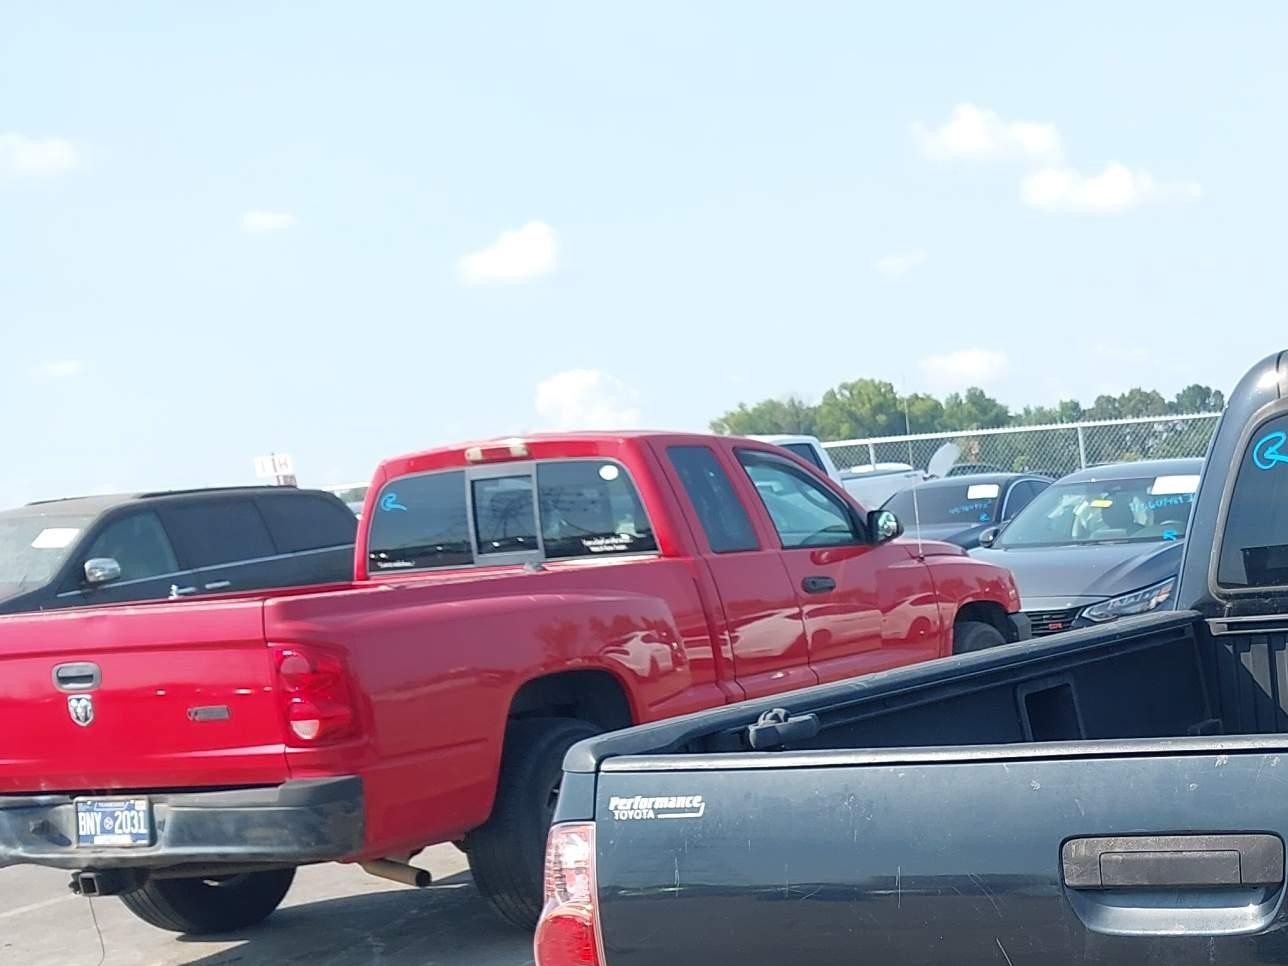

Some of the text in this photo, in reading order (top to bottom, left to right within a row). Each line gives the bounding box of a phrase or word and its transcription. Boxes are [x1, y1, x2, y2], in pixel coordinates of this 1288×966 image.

[608, 795, 703, 811] Performance
[78, 810, 148, 835] BNY 2031
[613, 809, 656, 821] TOYOTA
